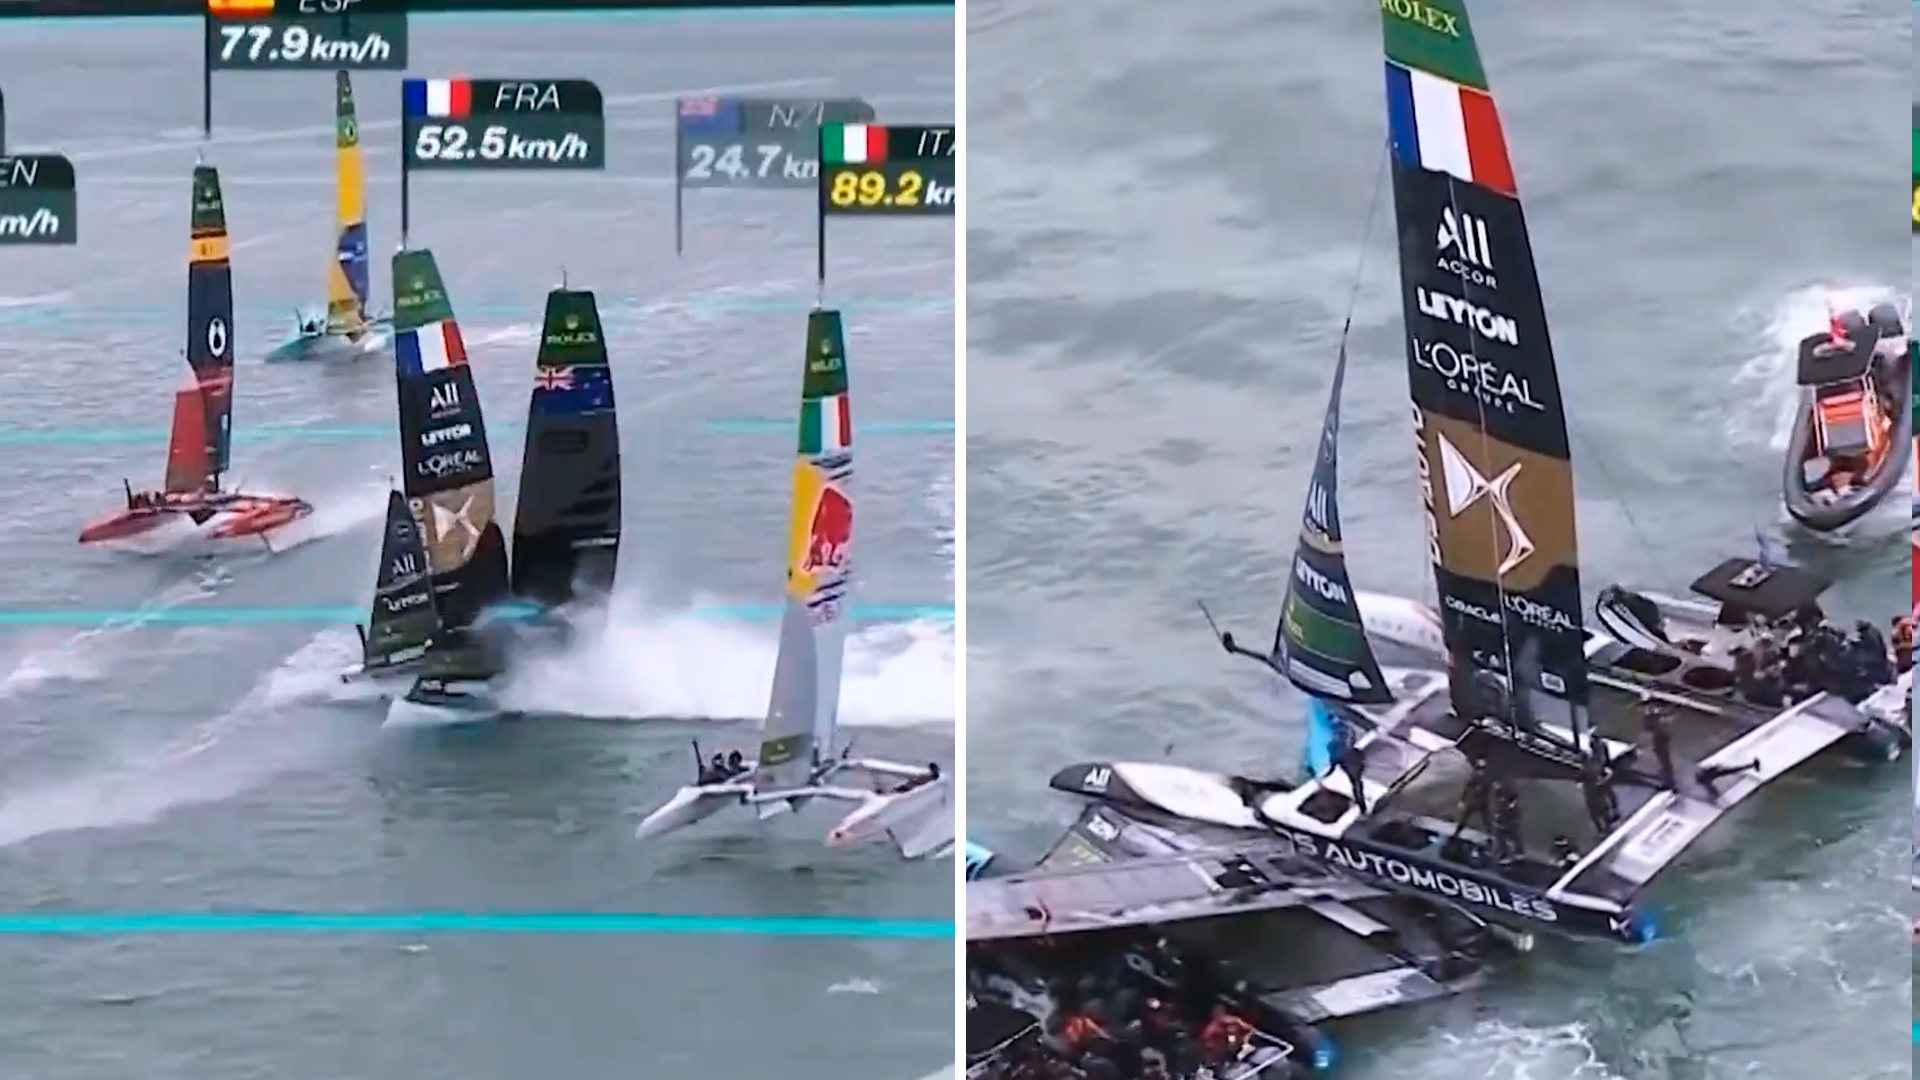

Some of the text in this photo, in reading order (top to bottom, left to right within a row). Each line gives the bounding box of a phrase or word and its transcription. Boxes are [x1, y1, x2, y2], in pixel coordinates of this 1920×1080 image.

[1437, 257, 1498, 290] ACCOR
[1417, 286, 1518, 345] LEYTON
[1325, 843, 1558, 922] AUTOMOBILES
